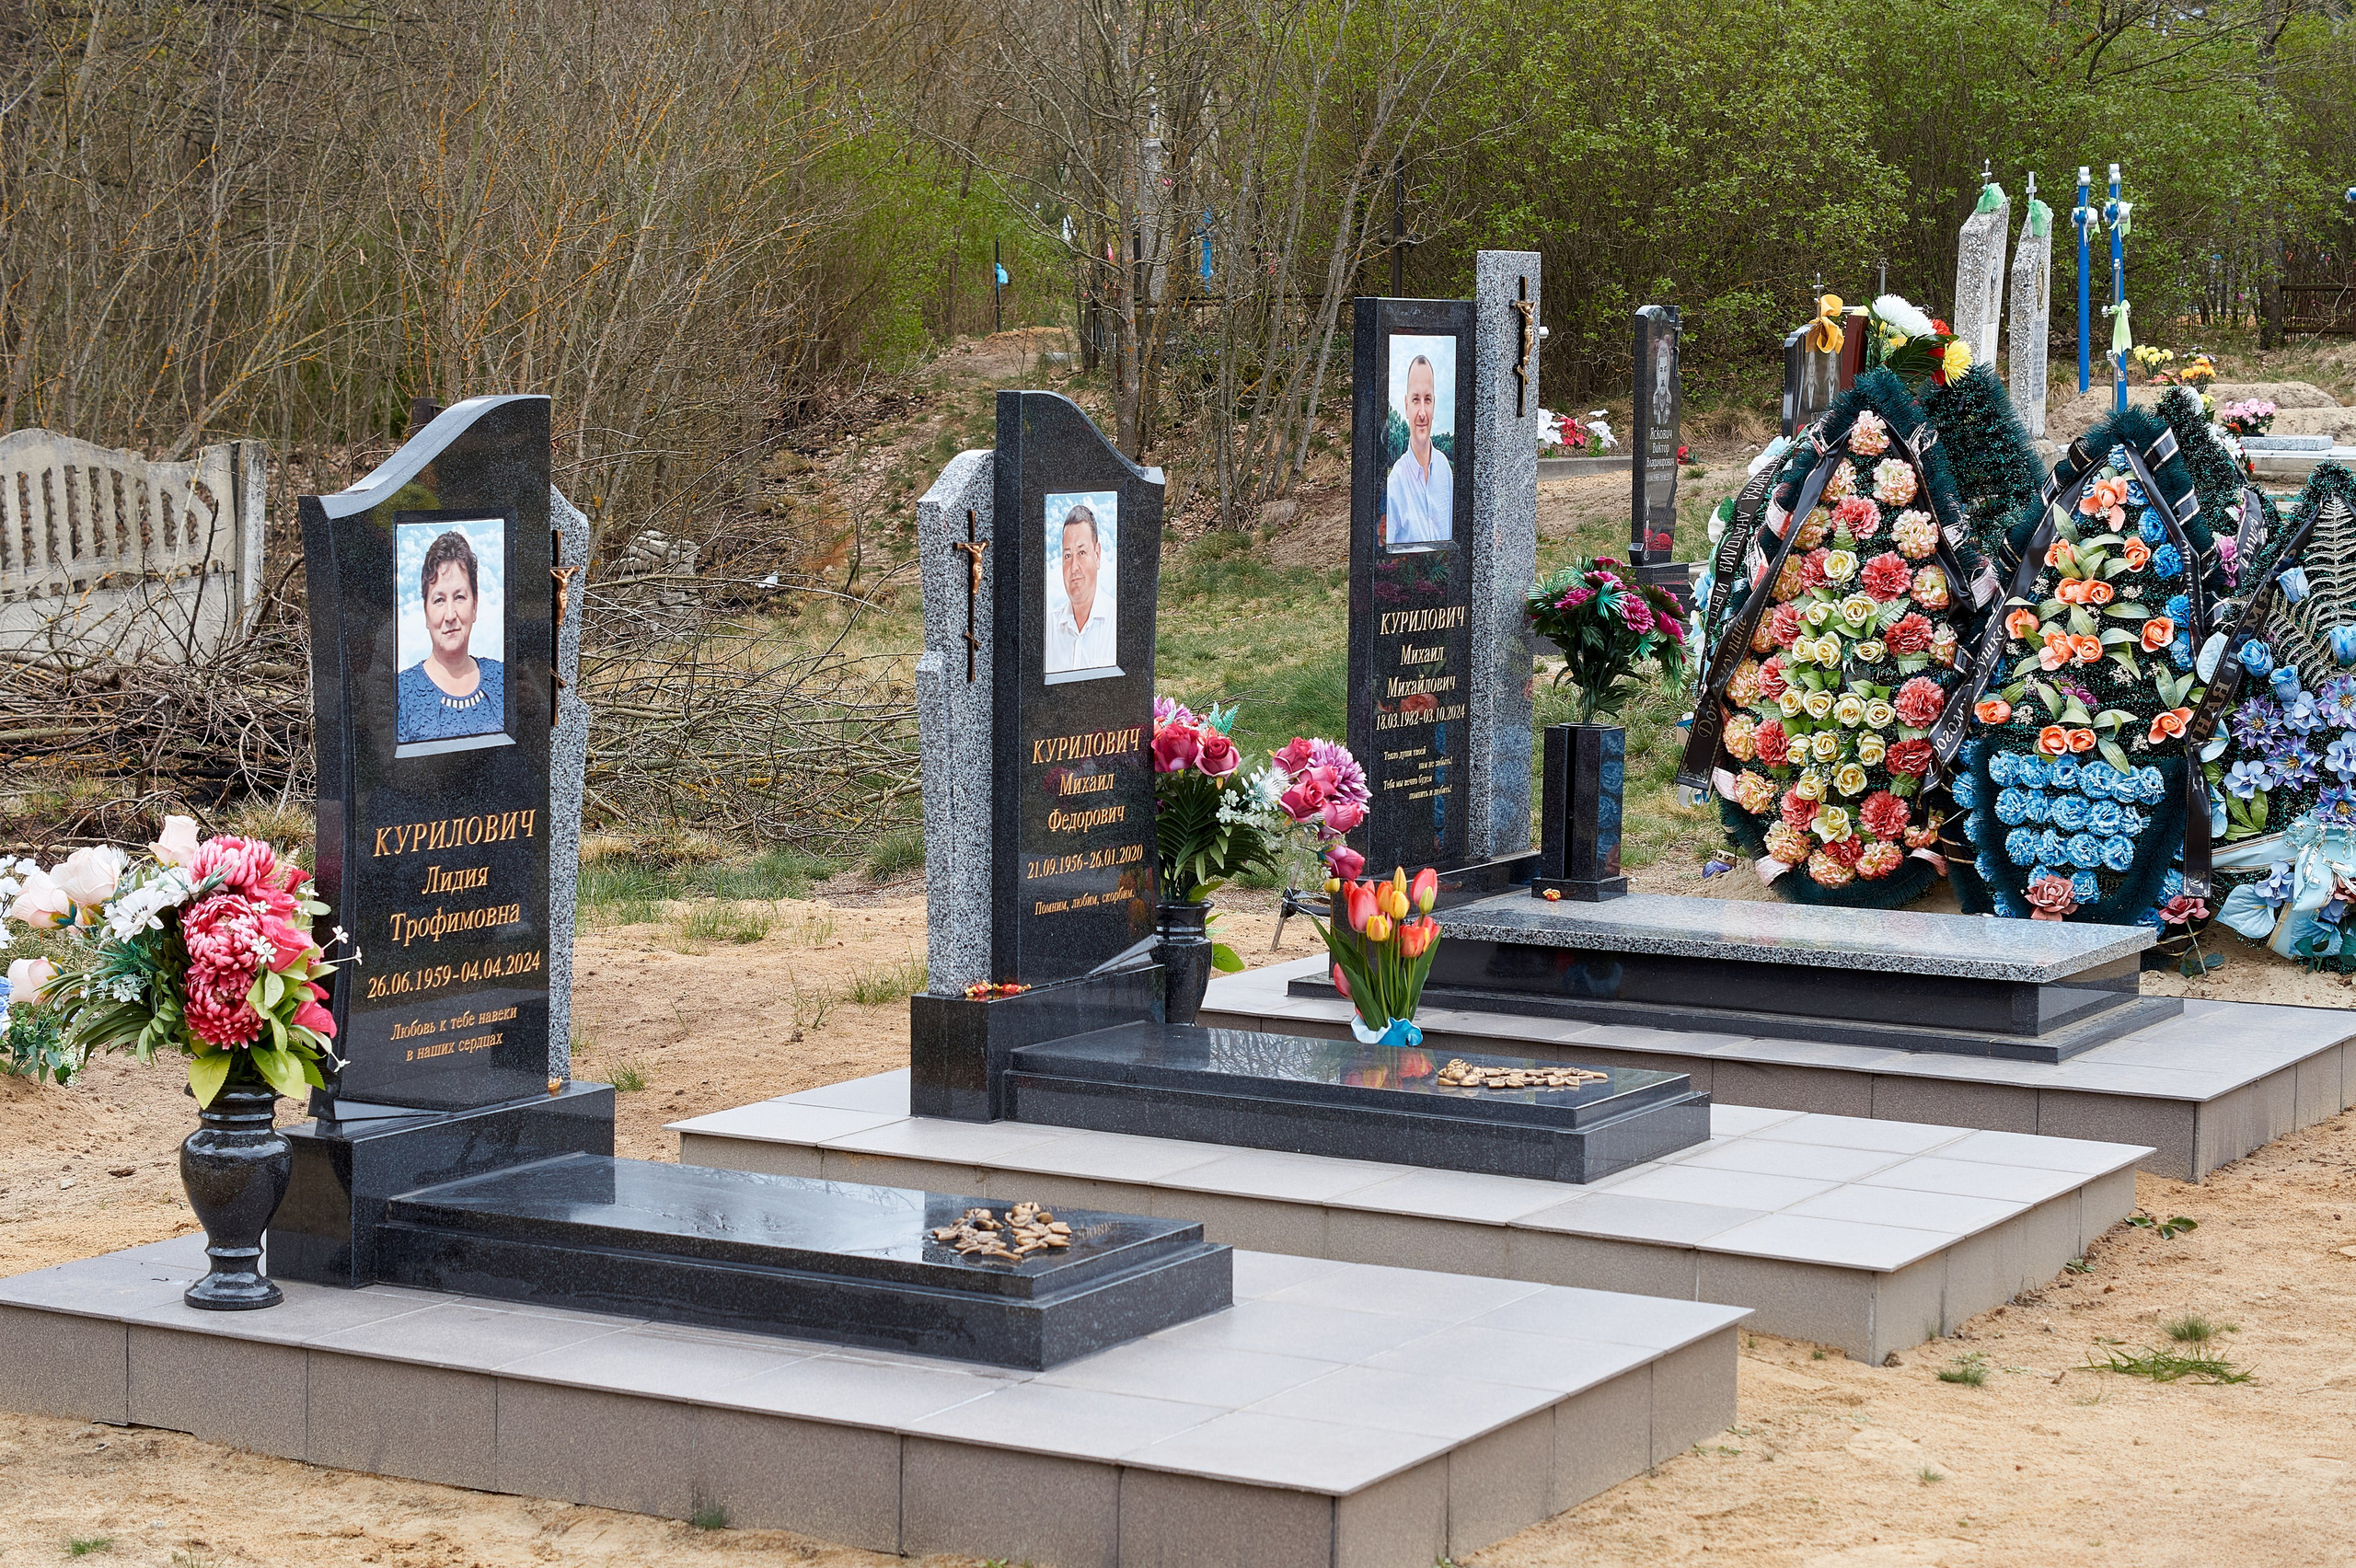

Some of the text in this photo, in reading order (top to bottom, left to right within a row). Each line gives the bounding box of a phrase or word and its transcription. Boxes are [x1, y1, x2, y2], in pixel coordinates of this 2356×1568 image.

[1719, 510, 1750, 573] АНАТОЛИЯ
[1380, 605, 1466, 635] КУРИЛОВИЧ
[1400, 644, 1445, 665] Михаил
[1386, 674, 1457, 698] Михайлович
[1375, 703, 1466, 731] 18.03.1982-03.10.2024
[1031, 727, 1141, 765] КУРИЛОВИЧ
[1058, 773, 1114, 797] Михаил
[372, 809, 537, 858] КУРИЛОВИЧ
[1047, 805, 1126, 834] Федорович
[1026, 844, 1144, 880] 21.09.1956-26.01.2020
[422, 866, 490, 896] Лидия
[1034, 886, 1136, 916] Помним, любим, скорбим.
[389, 902, 521, 947] Трофимовна
[366, 950, 541, 999] 26.06.1959-04.04.2024
[390, 1006, 518, 1041] Любовь к тебе навеки
[405, 1032, 503, 1062] в наших сердцах
